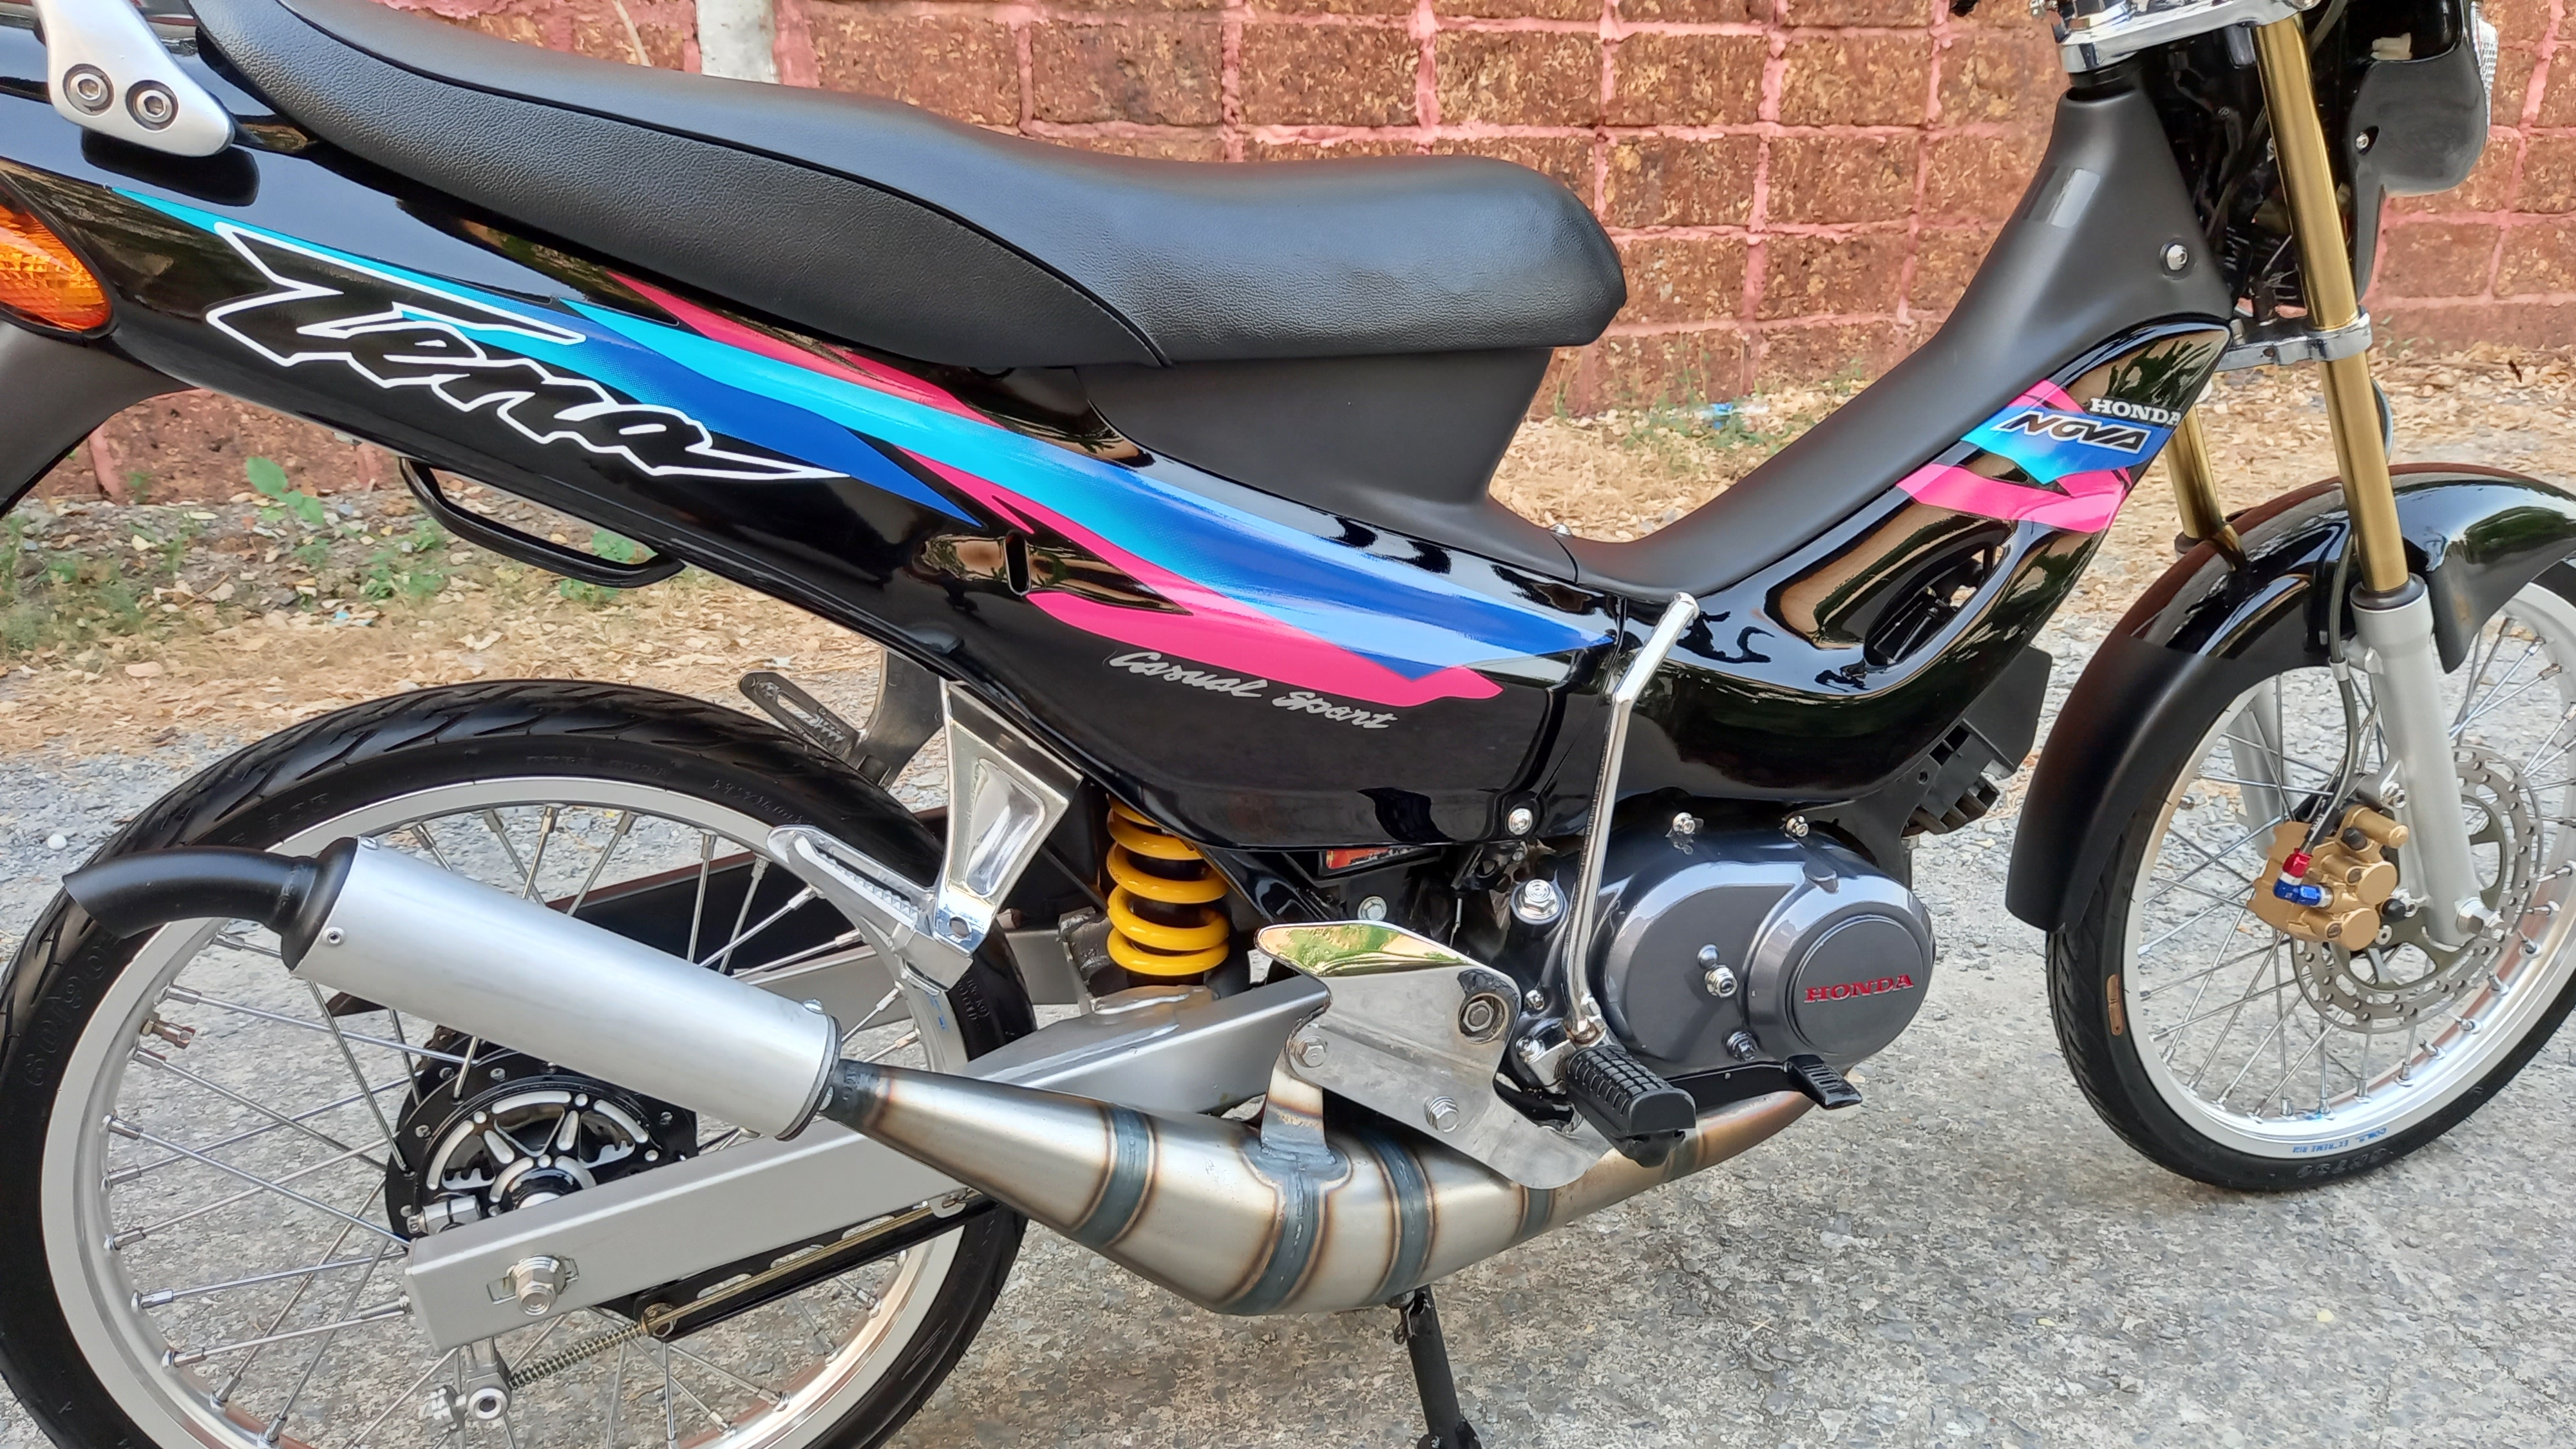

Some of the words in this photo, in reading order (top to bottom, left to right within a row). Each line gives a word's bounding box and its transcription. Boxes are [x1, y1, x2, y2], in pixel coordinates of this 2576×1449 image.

[2090, 397, 2182, 426] HONDA
[1990, 410, 2152, 454] NOVA
[1109, 652, 1269, 697] Casual
[1272, 691, 1398, 728] Sport
[1804, 974, 1914, 1003] HONDA
